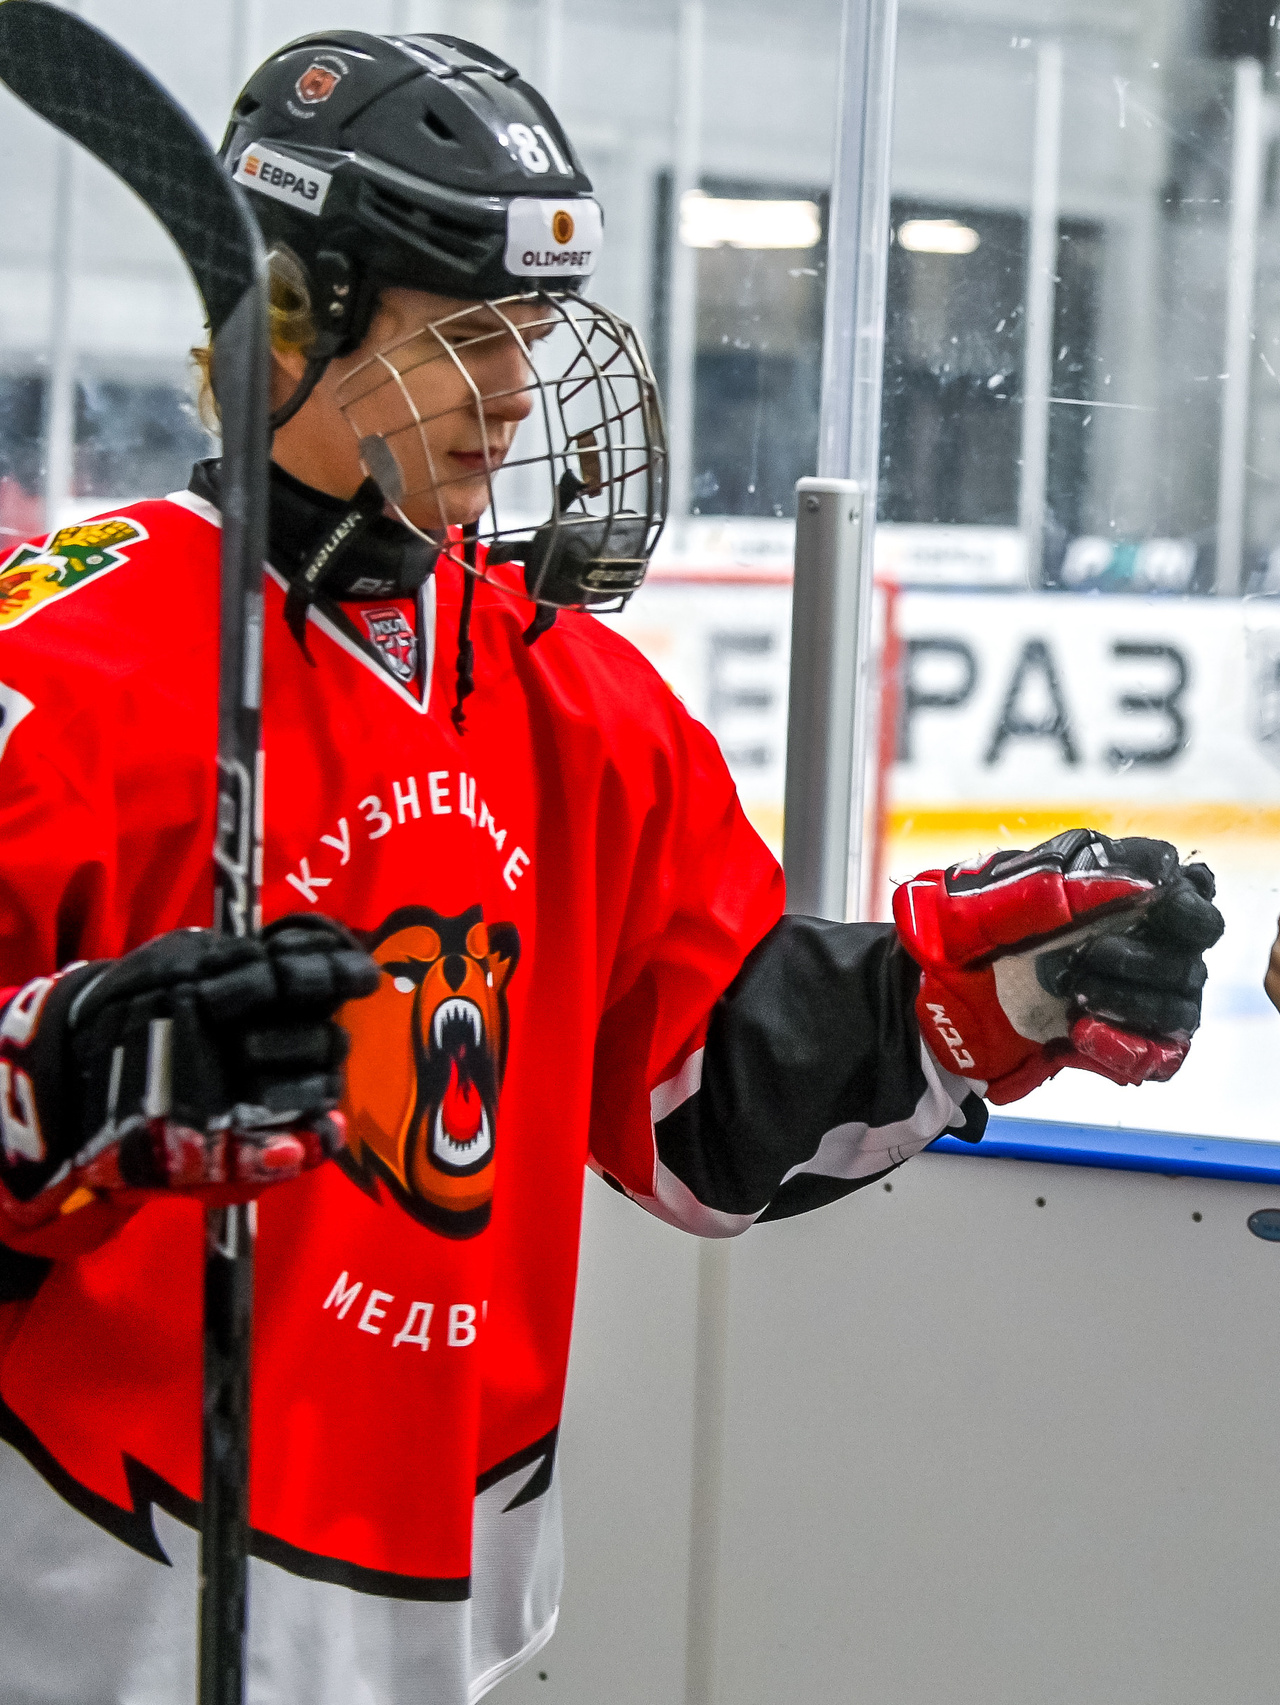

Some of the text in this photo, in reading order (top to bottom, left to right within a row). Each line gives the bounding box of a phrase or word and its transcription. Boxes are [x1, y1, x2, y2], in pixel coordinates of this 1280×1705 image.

[506, 122, 569, 175] 81
[259, 161, 319, 201] ЕВРАЗ
[521, 250, 592, 267] OLIMPBET
[705, 632, 1190, 770] ЕРАЗ
[925, 1003, 976, 1069] CCM
[322, 1270, 488, 1352] МЕДВ
